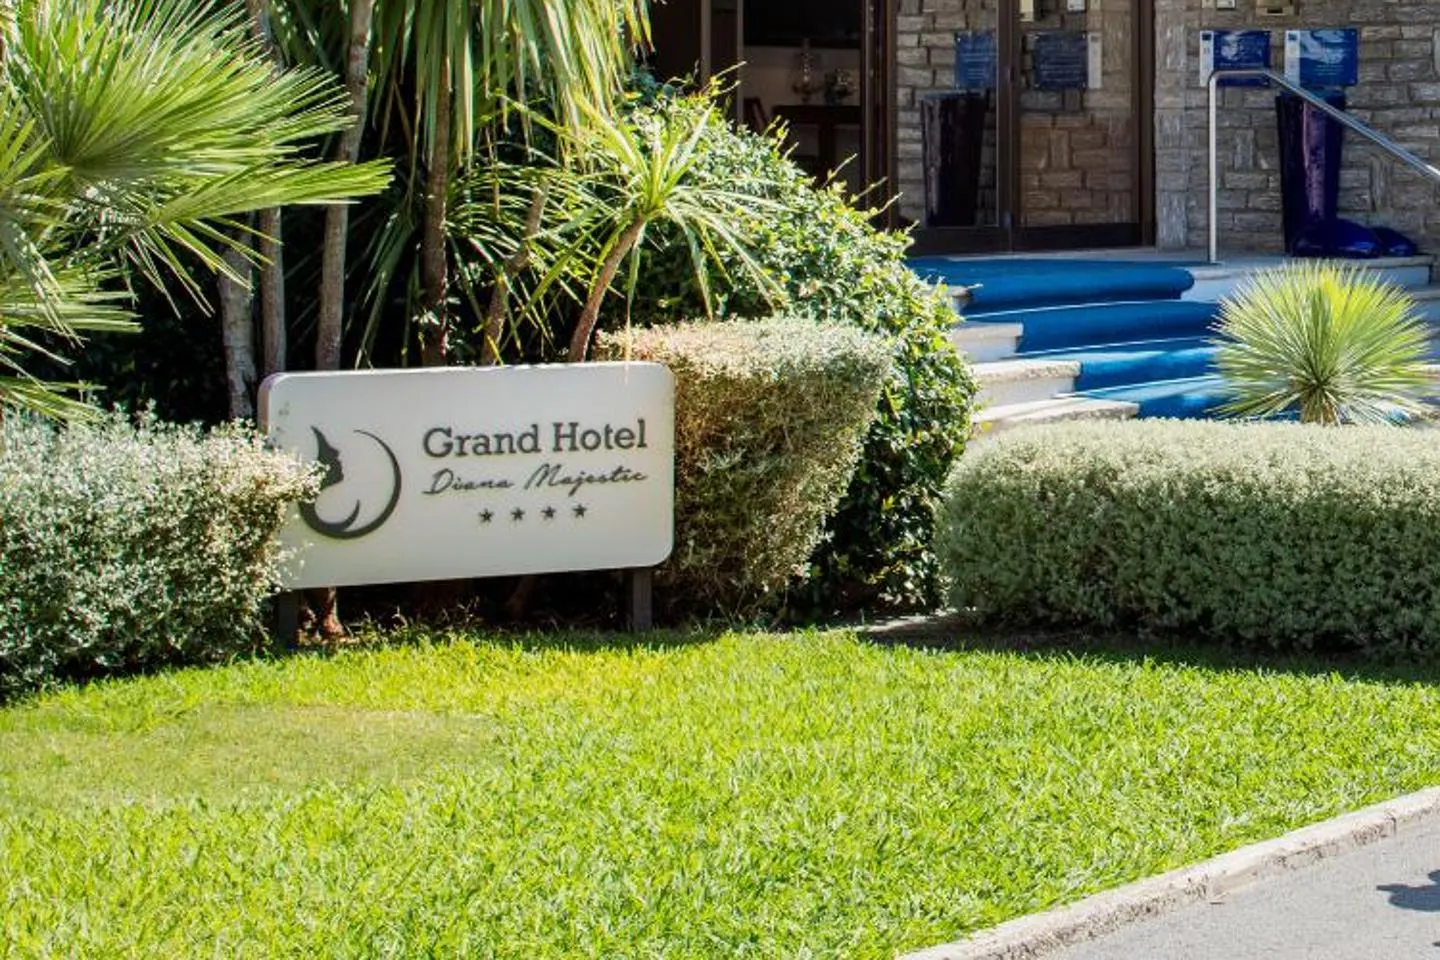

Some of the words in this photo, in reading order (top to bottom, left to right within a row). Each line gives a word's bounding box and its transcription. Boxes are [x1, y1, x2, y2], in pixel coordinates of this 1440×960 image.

[422, 423, 542, 458] Grand
[552, 418, 648, 452] Hotel
[421, 467, 515, 496] Diana
[523, 462, 649, 497] Majestic
